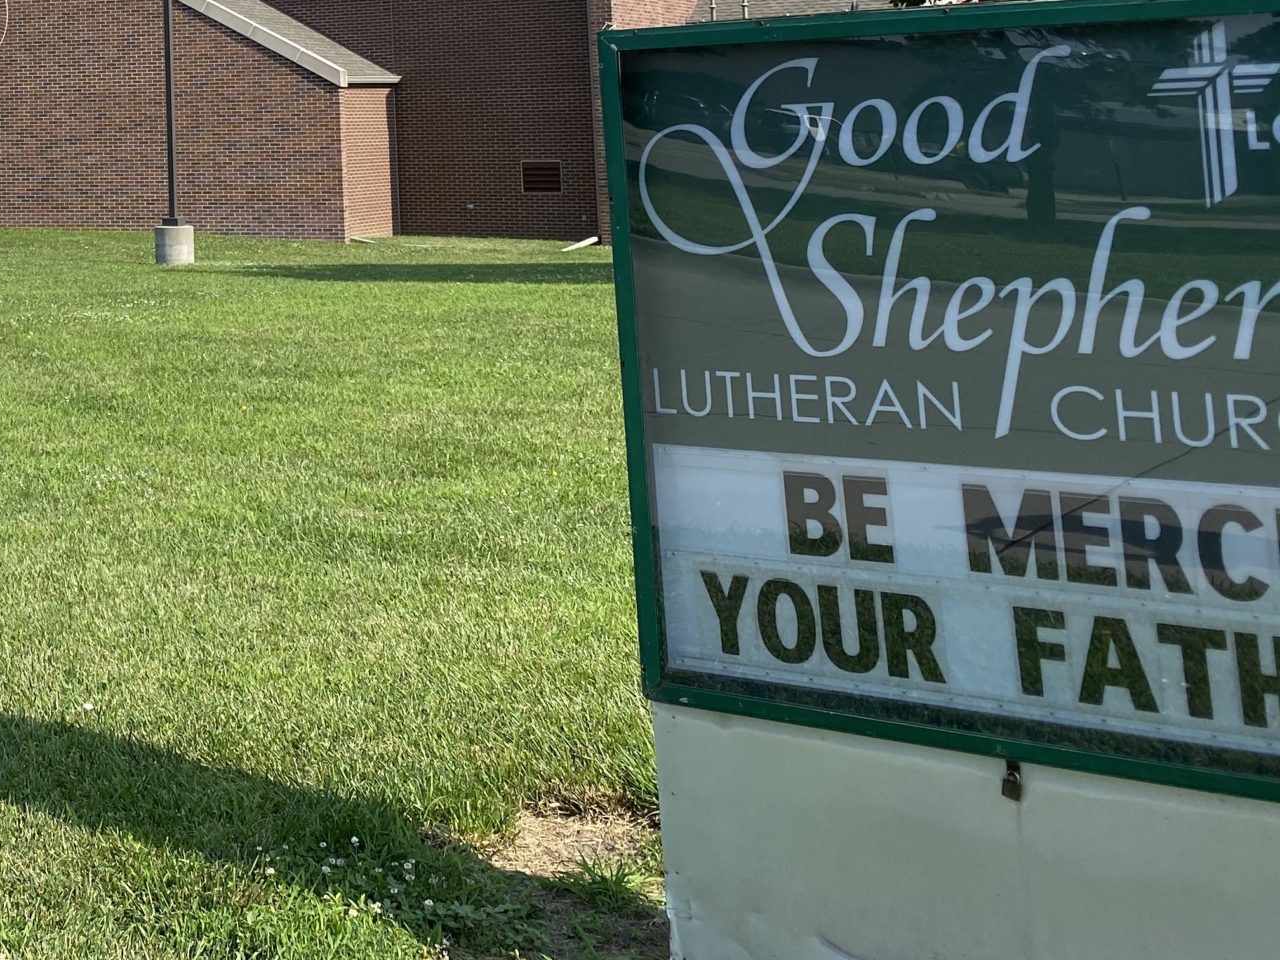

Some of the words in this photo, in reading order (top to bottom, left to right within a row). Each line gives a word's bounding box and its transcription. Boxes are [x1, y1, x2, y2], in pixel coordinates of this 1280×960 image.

[730, 44, 1072, 235] Good
[652, 367, 963, 431] LUTHERAN
[1050, 385, 1280, 451] CHUR
[783, 470, 896, 564] BE
[960, 483, 1280, 603] MERC
[700, 570, 947, 684] YOUR
[1012, 605, 1280, 729] FATH
